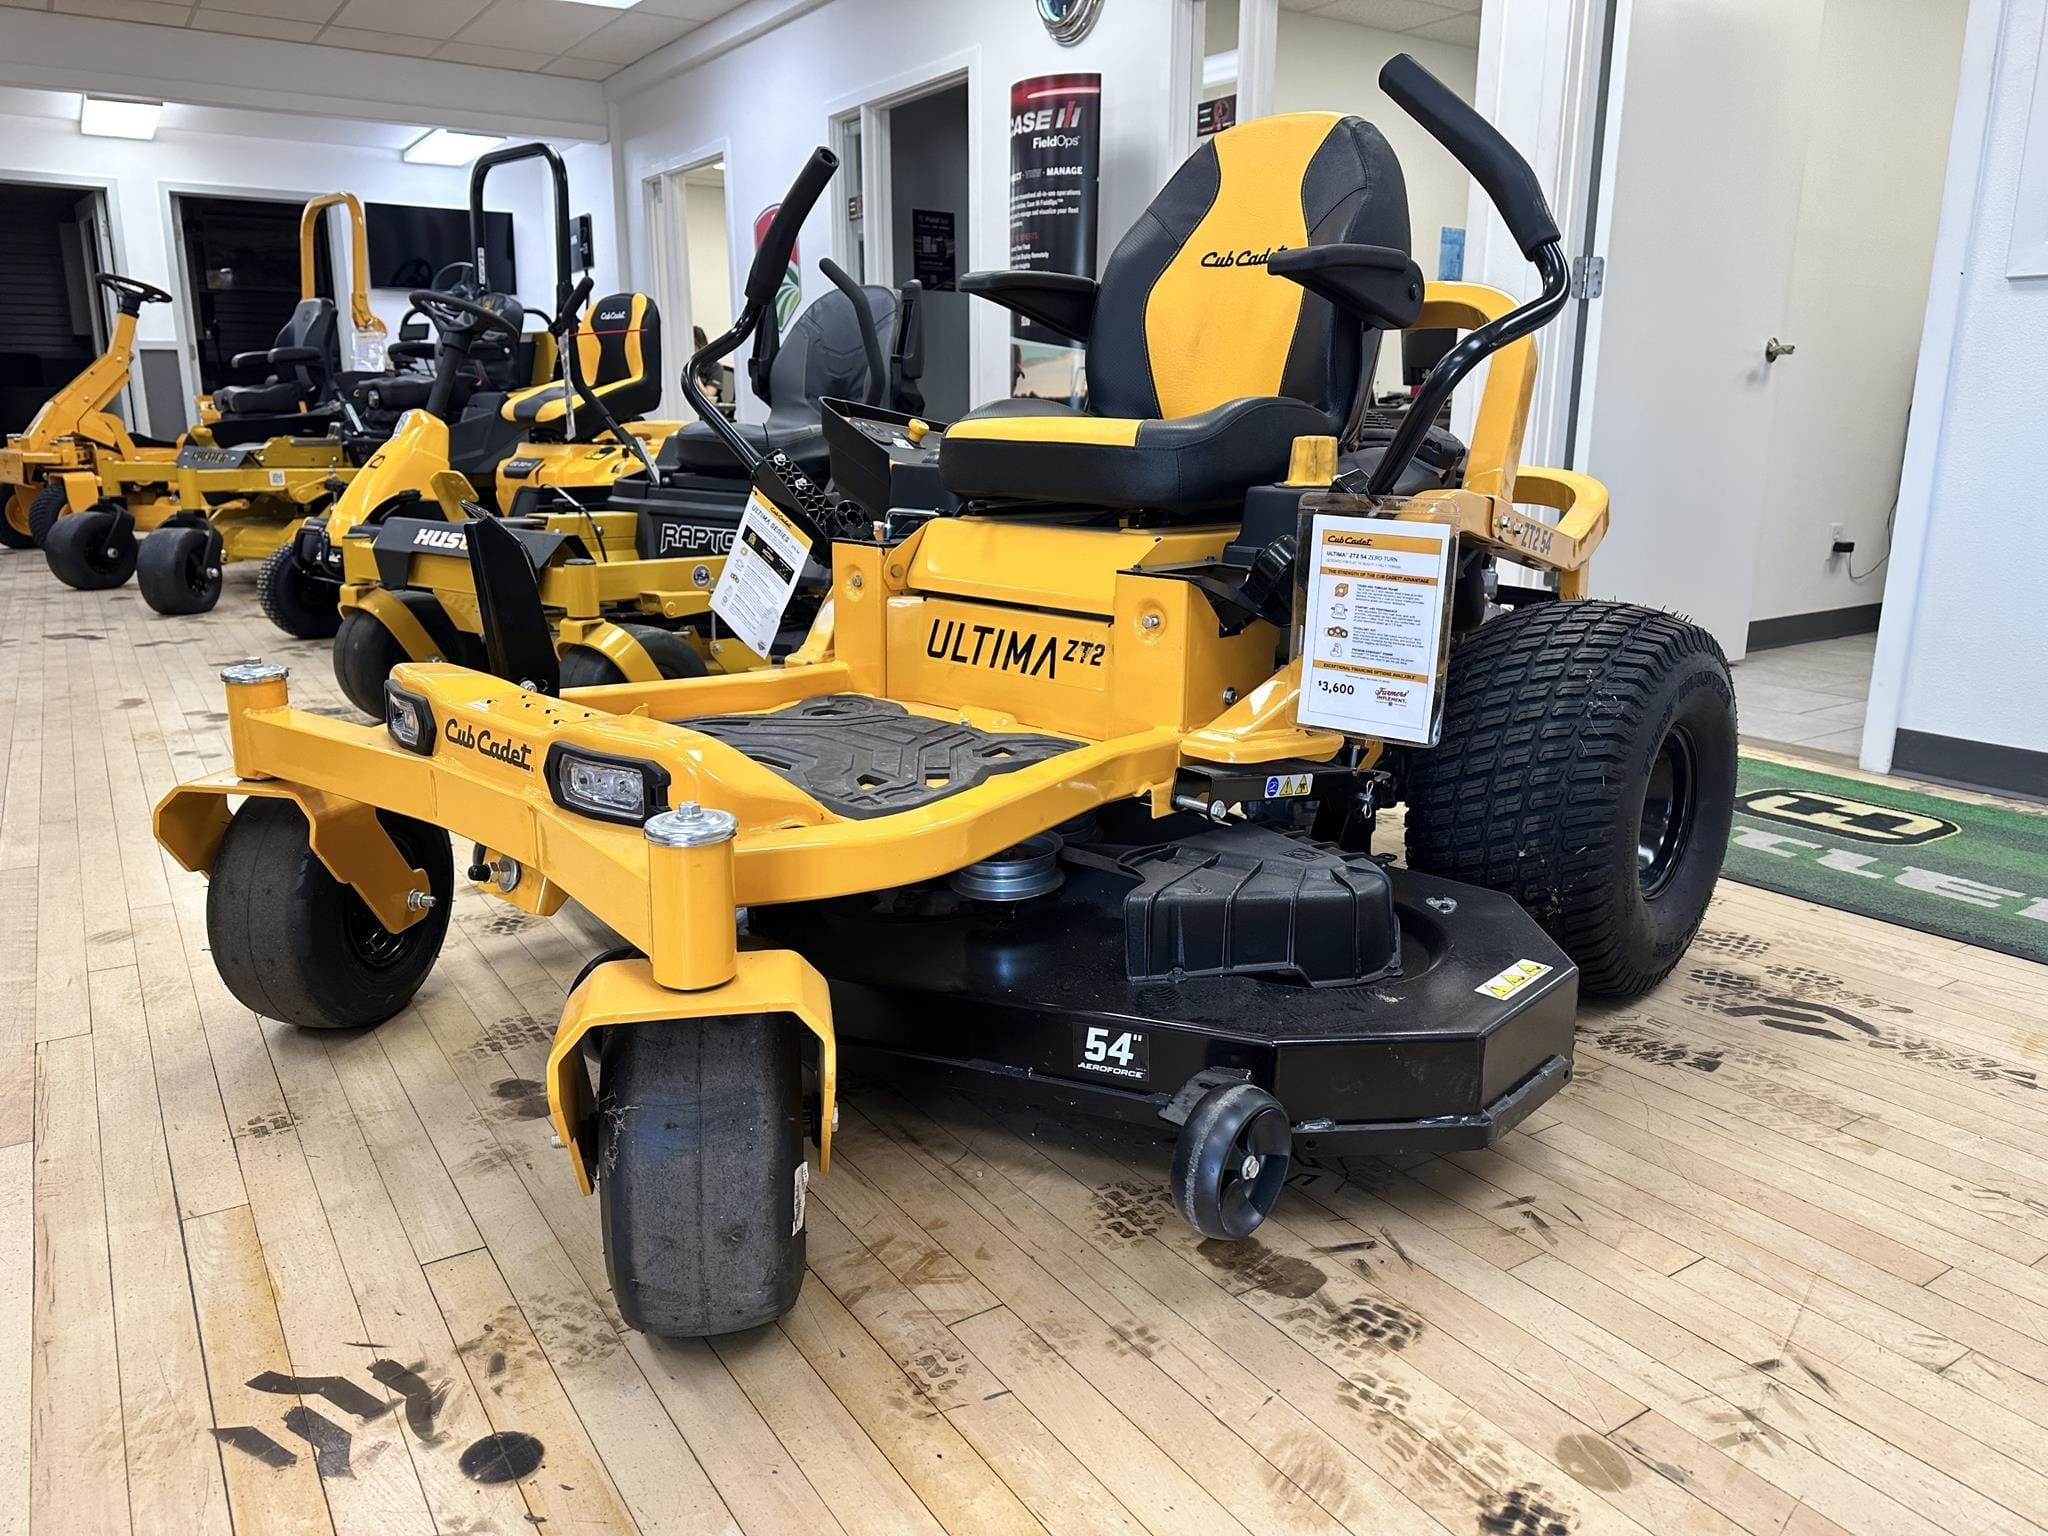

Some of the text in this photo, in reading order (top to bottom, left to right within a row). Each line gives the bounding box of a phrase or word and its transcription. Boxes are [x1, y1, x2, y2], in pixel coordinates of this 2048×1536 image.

[1046, 166, 1083, 176] MANAGE
[1201, 250, 1234, 267] Cub
[1328, 535, 1373, 546] Cub Cadet
[926, 618, 1106, 680] ULTIMA ZT2
[1318, 680, 1354, 695] $3,600
[445, 718, 532, 771] Cub Cadet
[1078, 1062, 1146, 1079] AEROFORCE
